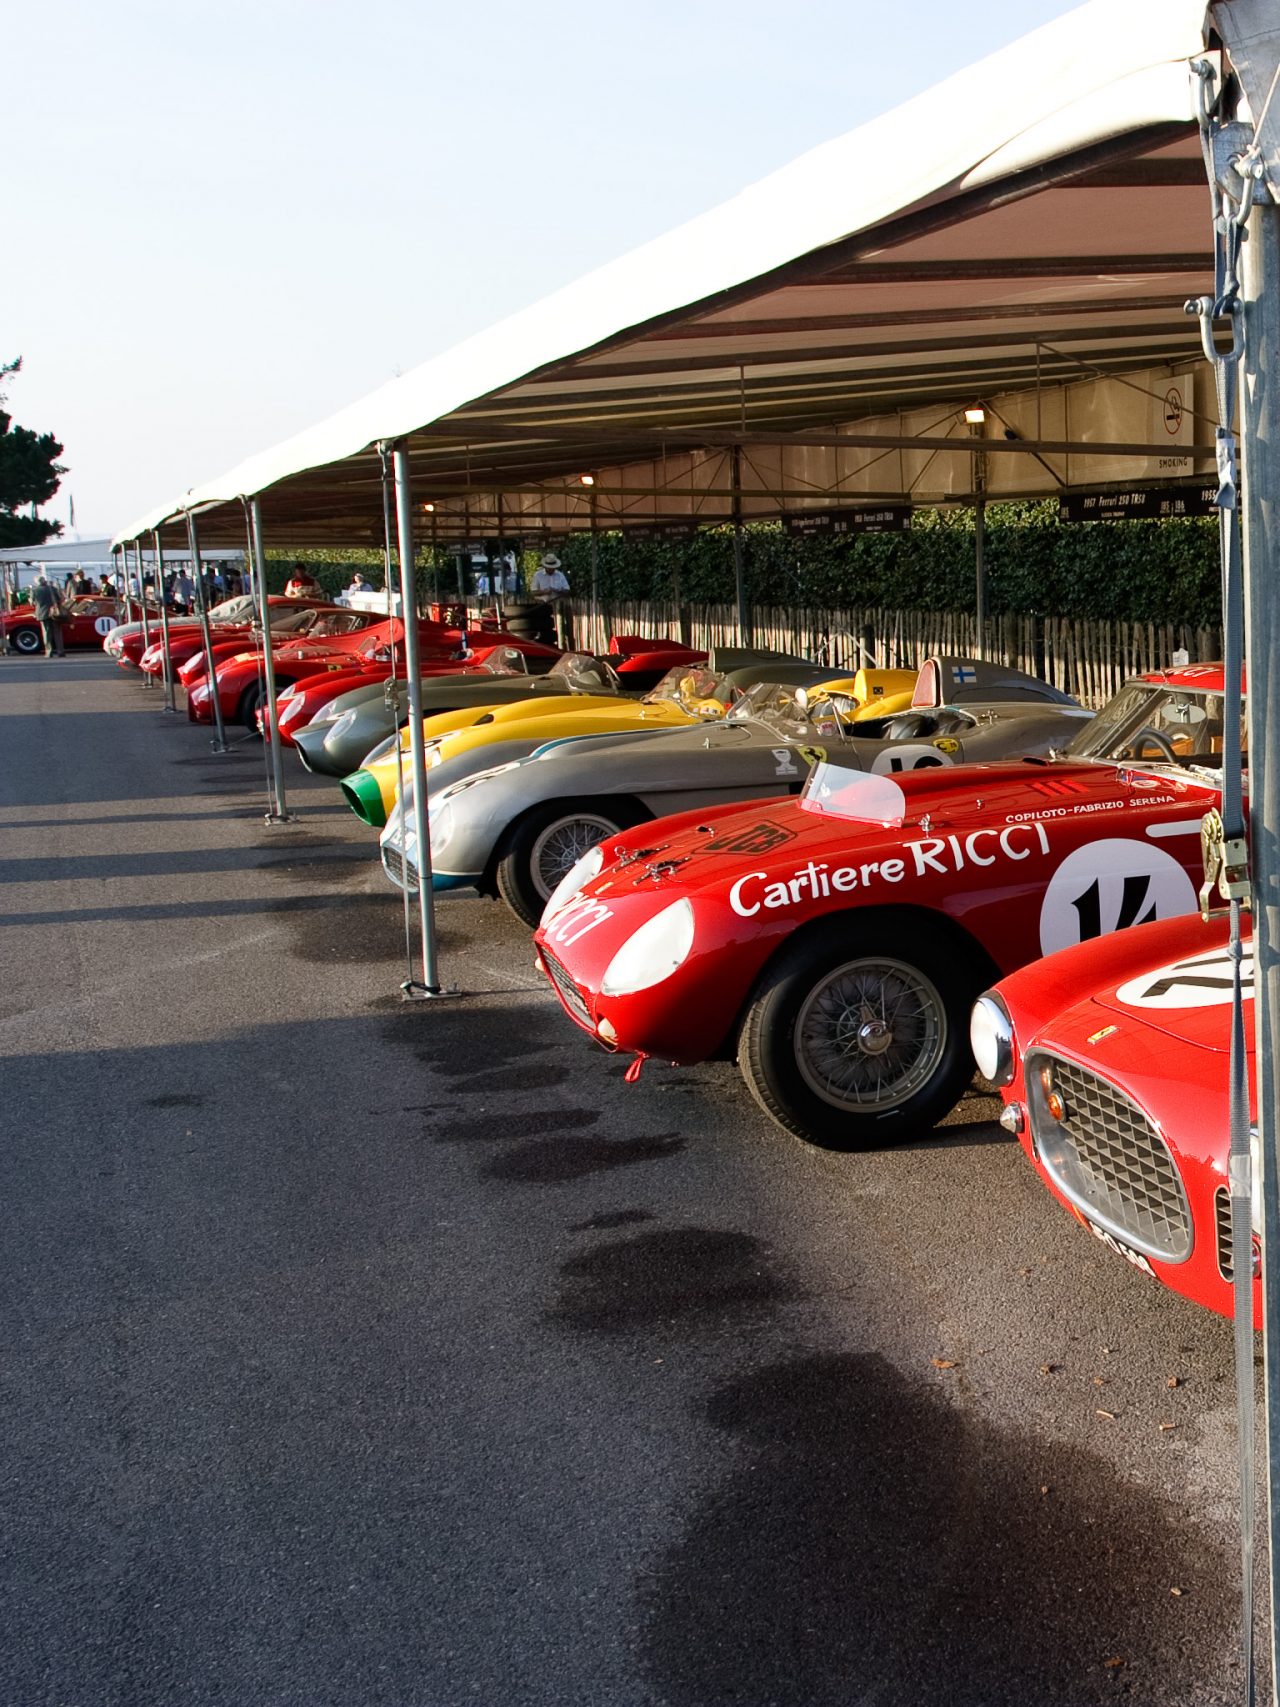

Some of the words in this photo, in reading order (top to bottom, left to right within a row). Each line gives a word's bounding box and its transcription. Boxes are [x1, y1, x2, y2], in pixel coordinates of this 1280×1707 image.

[1159, 456, 1188, 469] SMOKING
[1005, 800, 1124, 823] COPILOTO-FABRIZIO
[1130, 795, 1176, 807] SERENA
[729, 861, 905, 917] Cartiere
[902, 822, 1050, 877] RICCI
